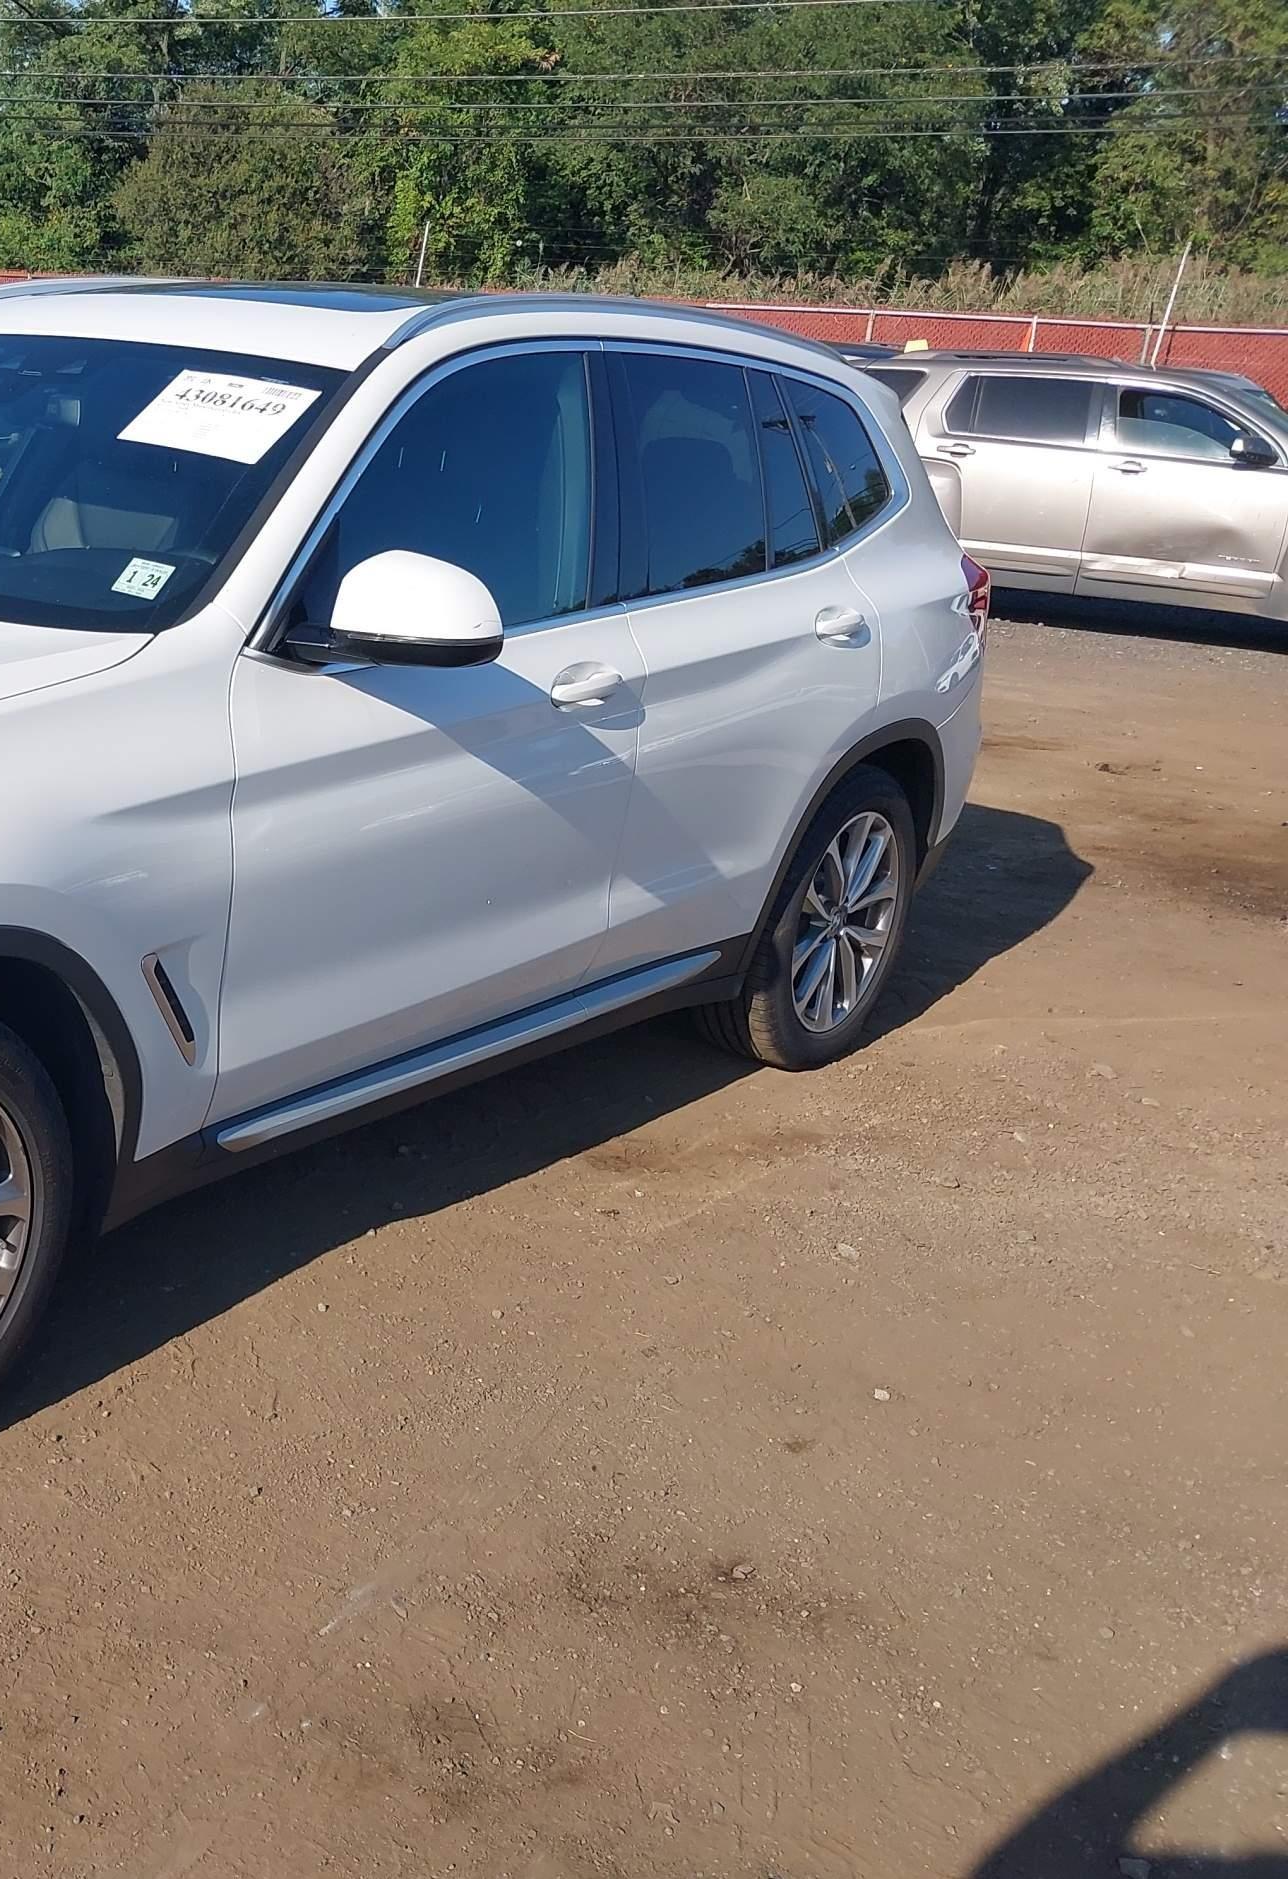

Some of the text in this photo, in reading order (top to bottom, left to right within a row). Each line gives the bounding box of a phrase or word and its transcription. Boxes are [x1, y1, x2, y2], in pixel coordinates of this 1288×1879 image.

[175, 387, 287, 416] 43081649
[125, 570, 162, 589] 1 24
